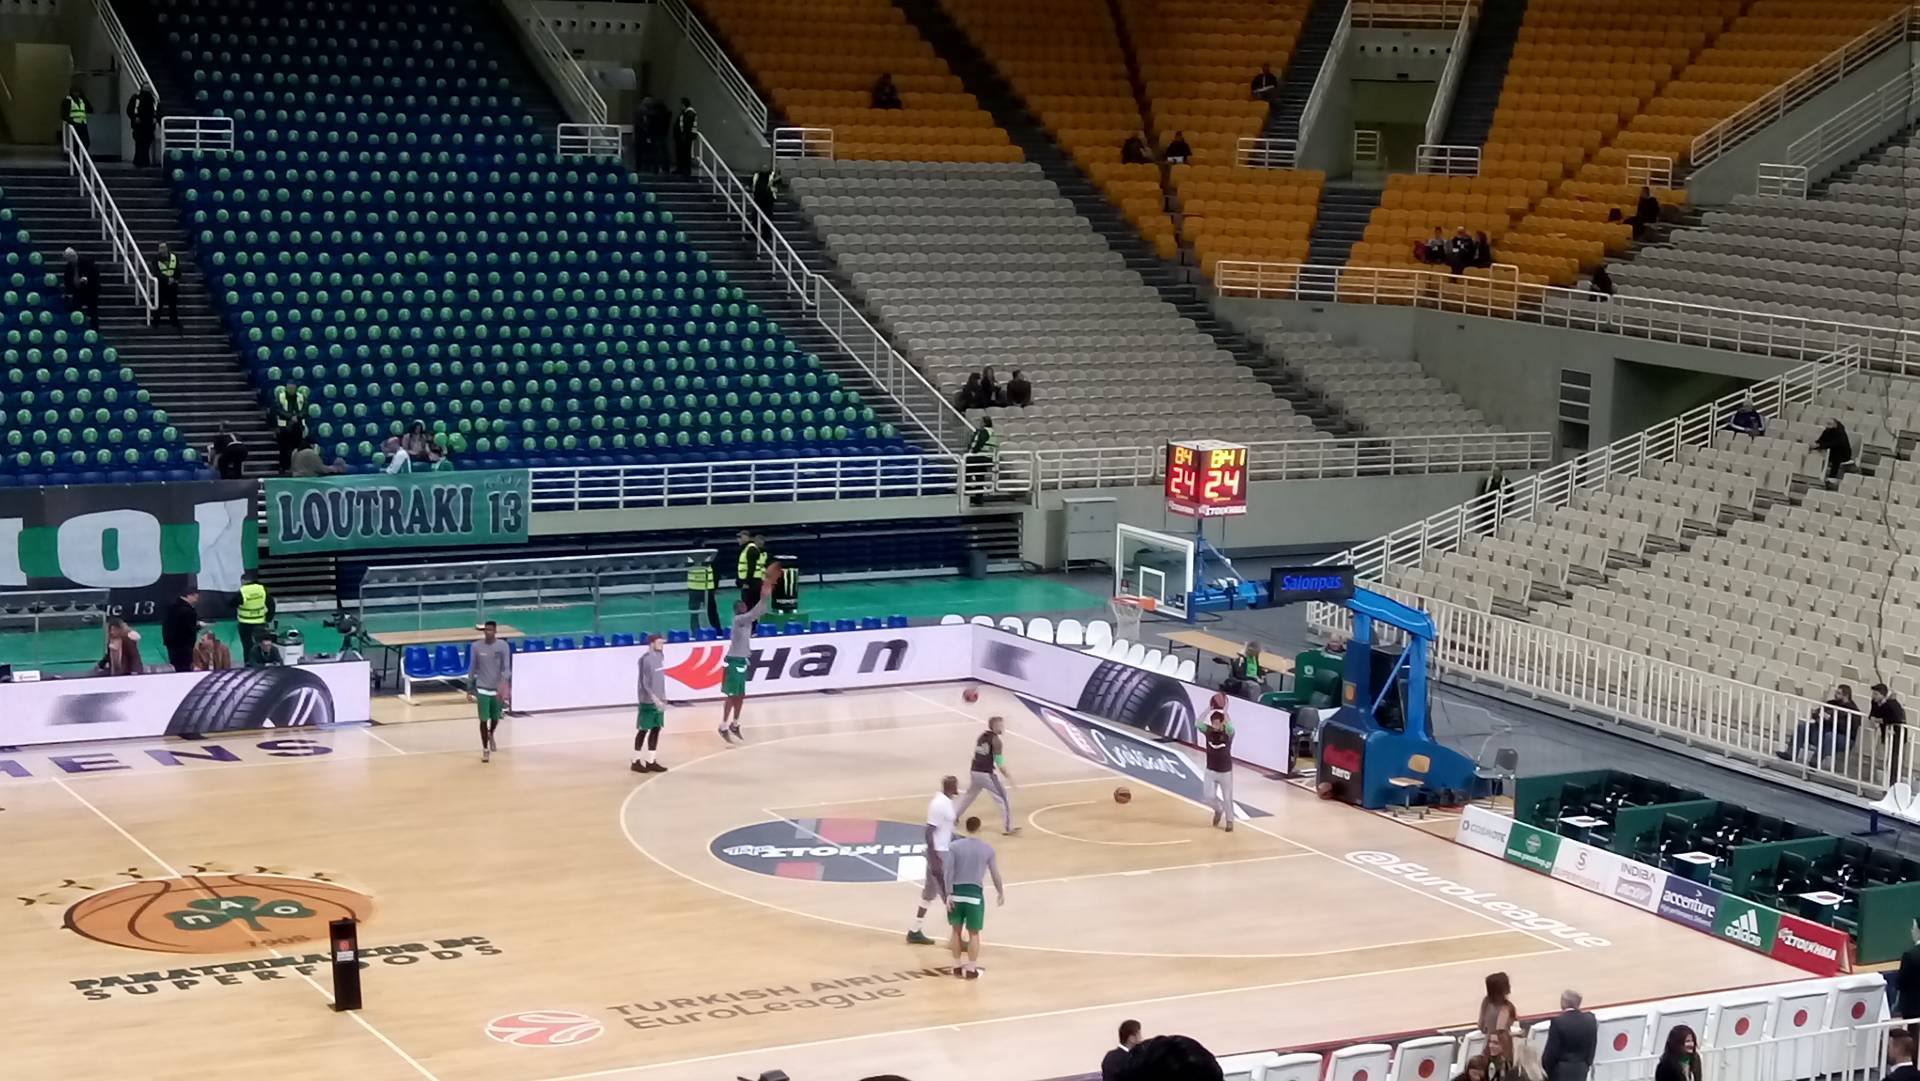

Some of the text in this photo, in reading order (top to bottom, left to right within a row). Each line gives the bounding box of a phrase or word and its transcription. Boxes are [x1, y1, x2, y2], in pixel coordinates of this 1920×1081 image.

[1171, 467, 1196, 497] 24
[1205, 470, 1240, 499] 24
[277, 485, 523, 543] LOUTRAKI 13
[1281, 574, 1343, 592] Salonpas
[132, 602, 156, 617] 13
[1345, 850, 1612, 948] @EuroLeague
[1663, 890, 1716, 918] accenture
[1724, 925, 1761, 947] adidas
[70, 943, 428, 991] PANATHINAKOS
[606, 965, 956, 1017] TURKISH AIRLINE
[623, 985, 907, 1031] EuroLeague
